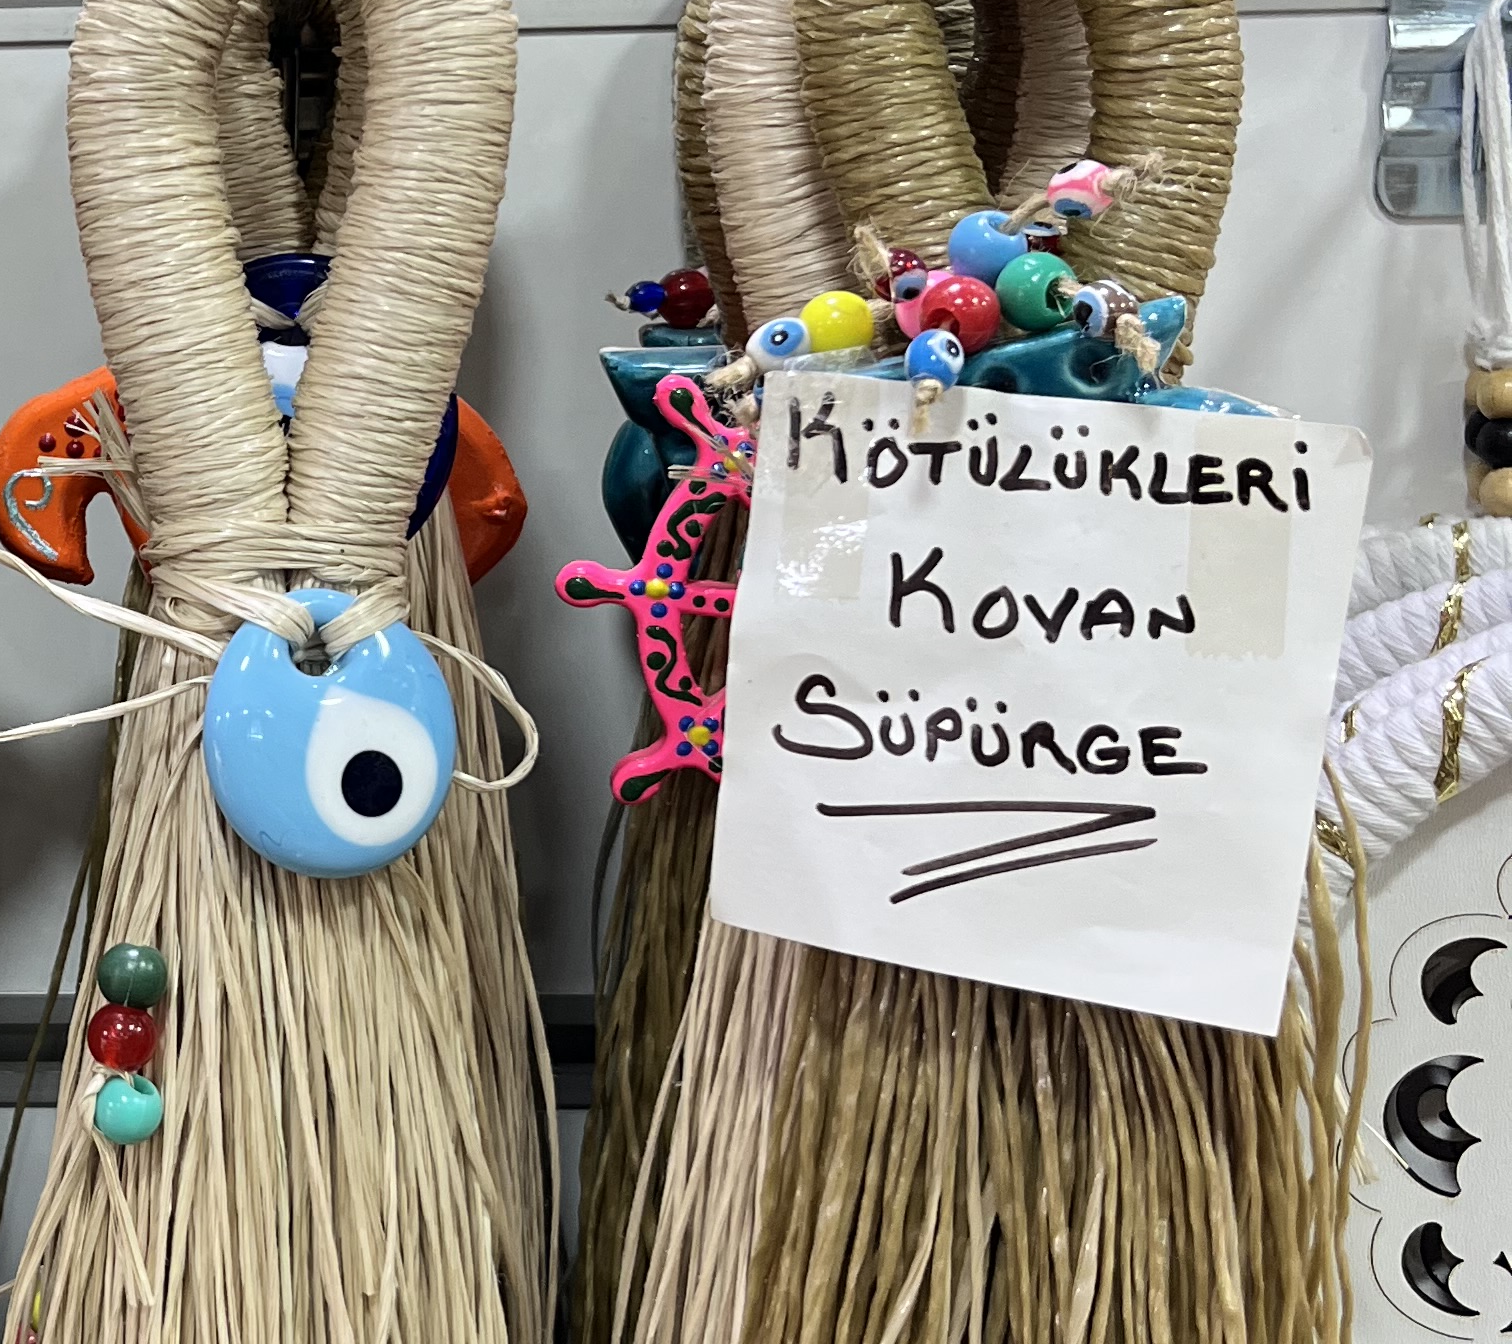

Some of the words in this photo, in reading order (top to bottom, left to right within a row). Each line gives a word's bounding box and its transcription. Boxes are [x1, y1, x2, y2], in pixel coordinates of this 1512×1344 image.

[787, 391, 1311, 513] KÖTÜLÜKLERİ
[889, 547, 1196, 644] KOVAN
[772, 673, 1209, 776] SÜPÜRGE
